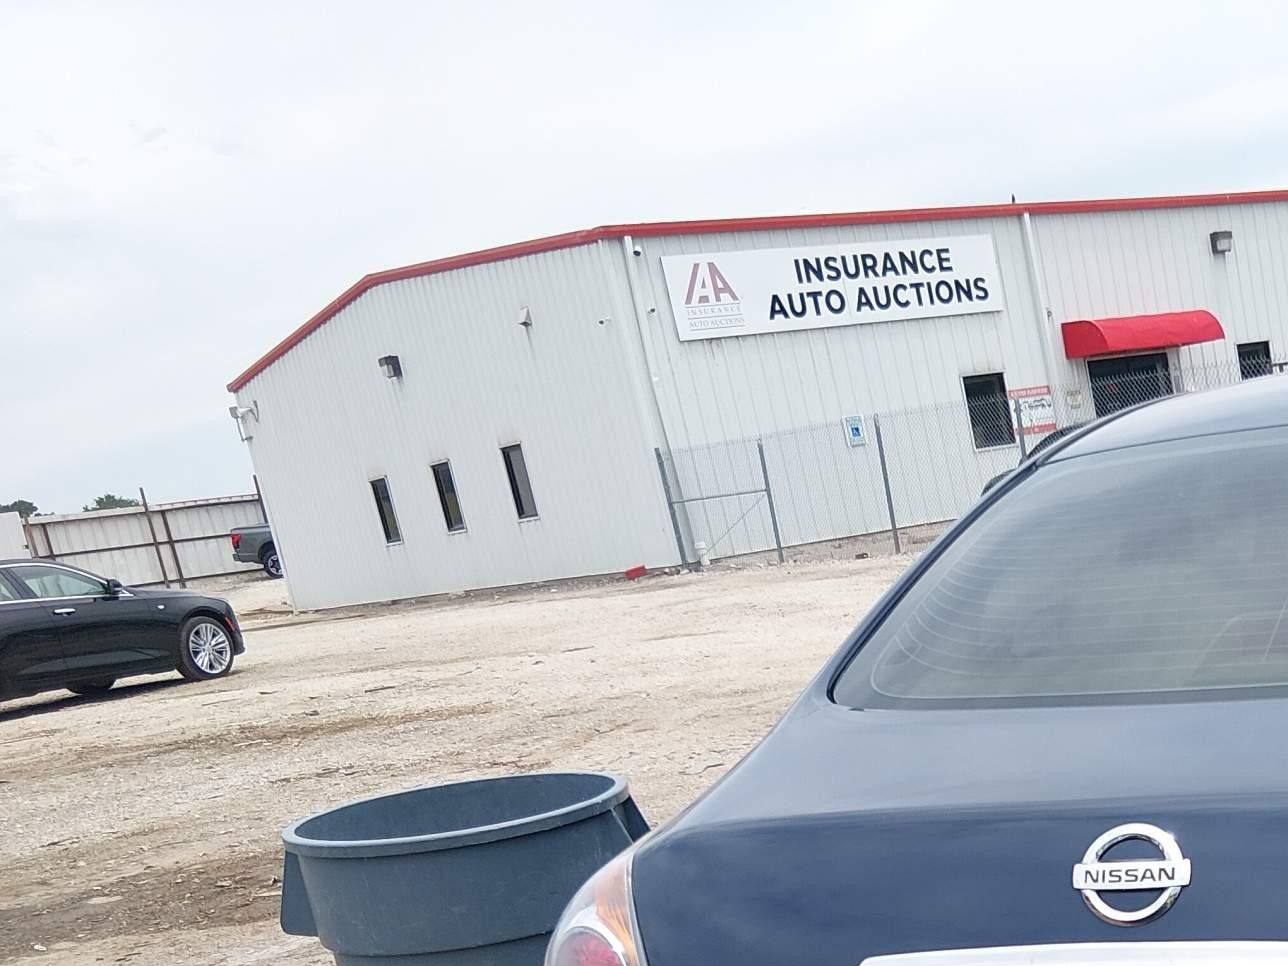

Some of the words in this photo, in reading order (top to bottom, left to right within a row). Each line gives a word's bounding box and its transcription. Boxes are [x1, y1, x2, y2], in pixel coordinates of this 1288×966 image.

[794, 248, 953, 284] INSURANCE
[769, 289, 846, 321] AUTO
[856, 277, 989, 312] AUCTIONS
[687, 304, 742, 317] INSURANCE
[689, 319, 710, 329] AUTO
[1084, 867, 1175, 884] NISSAN
